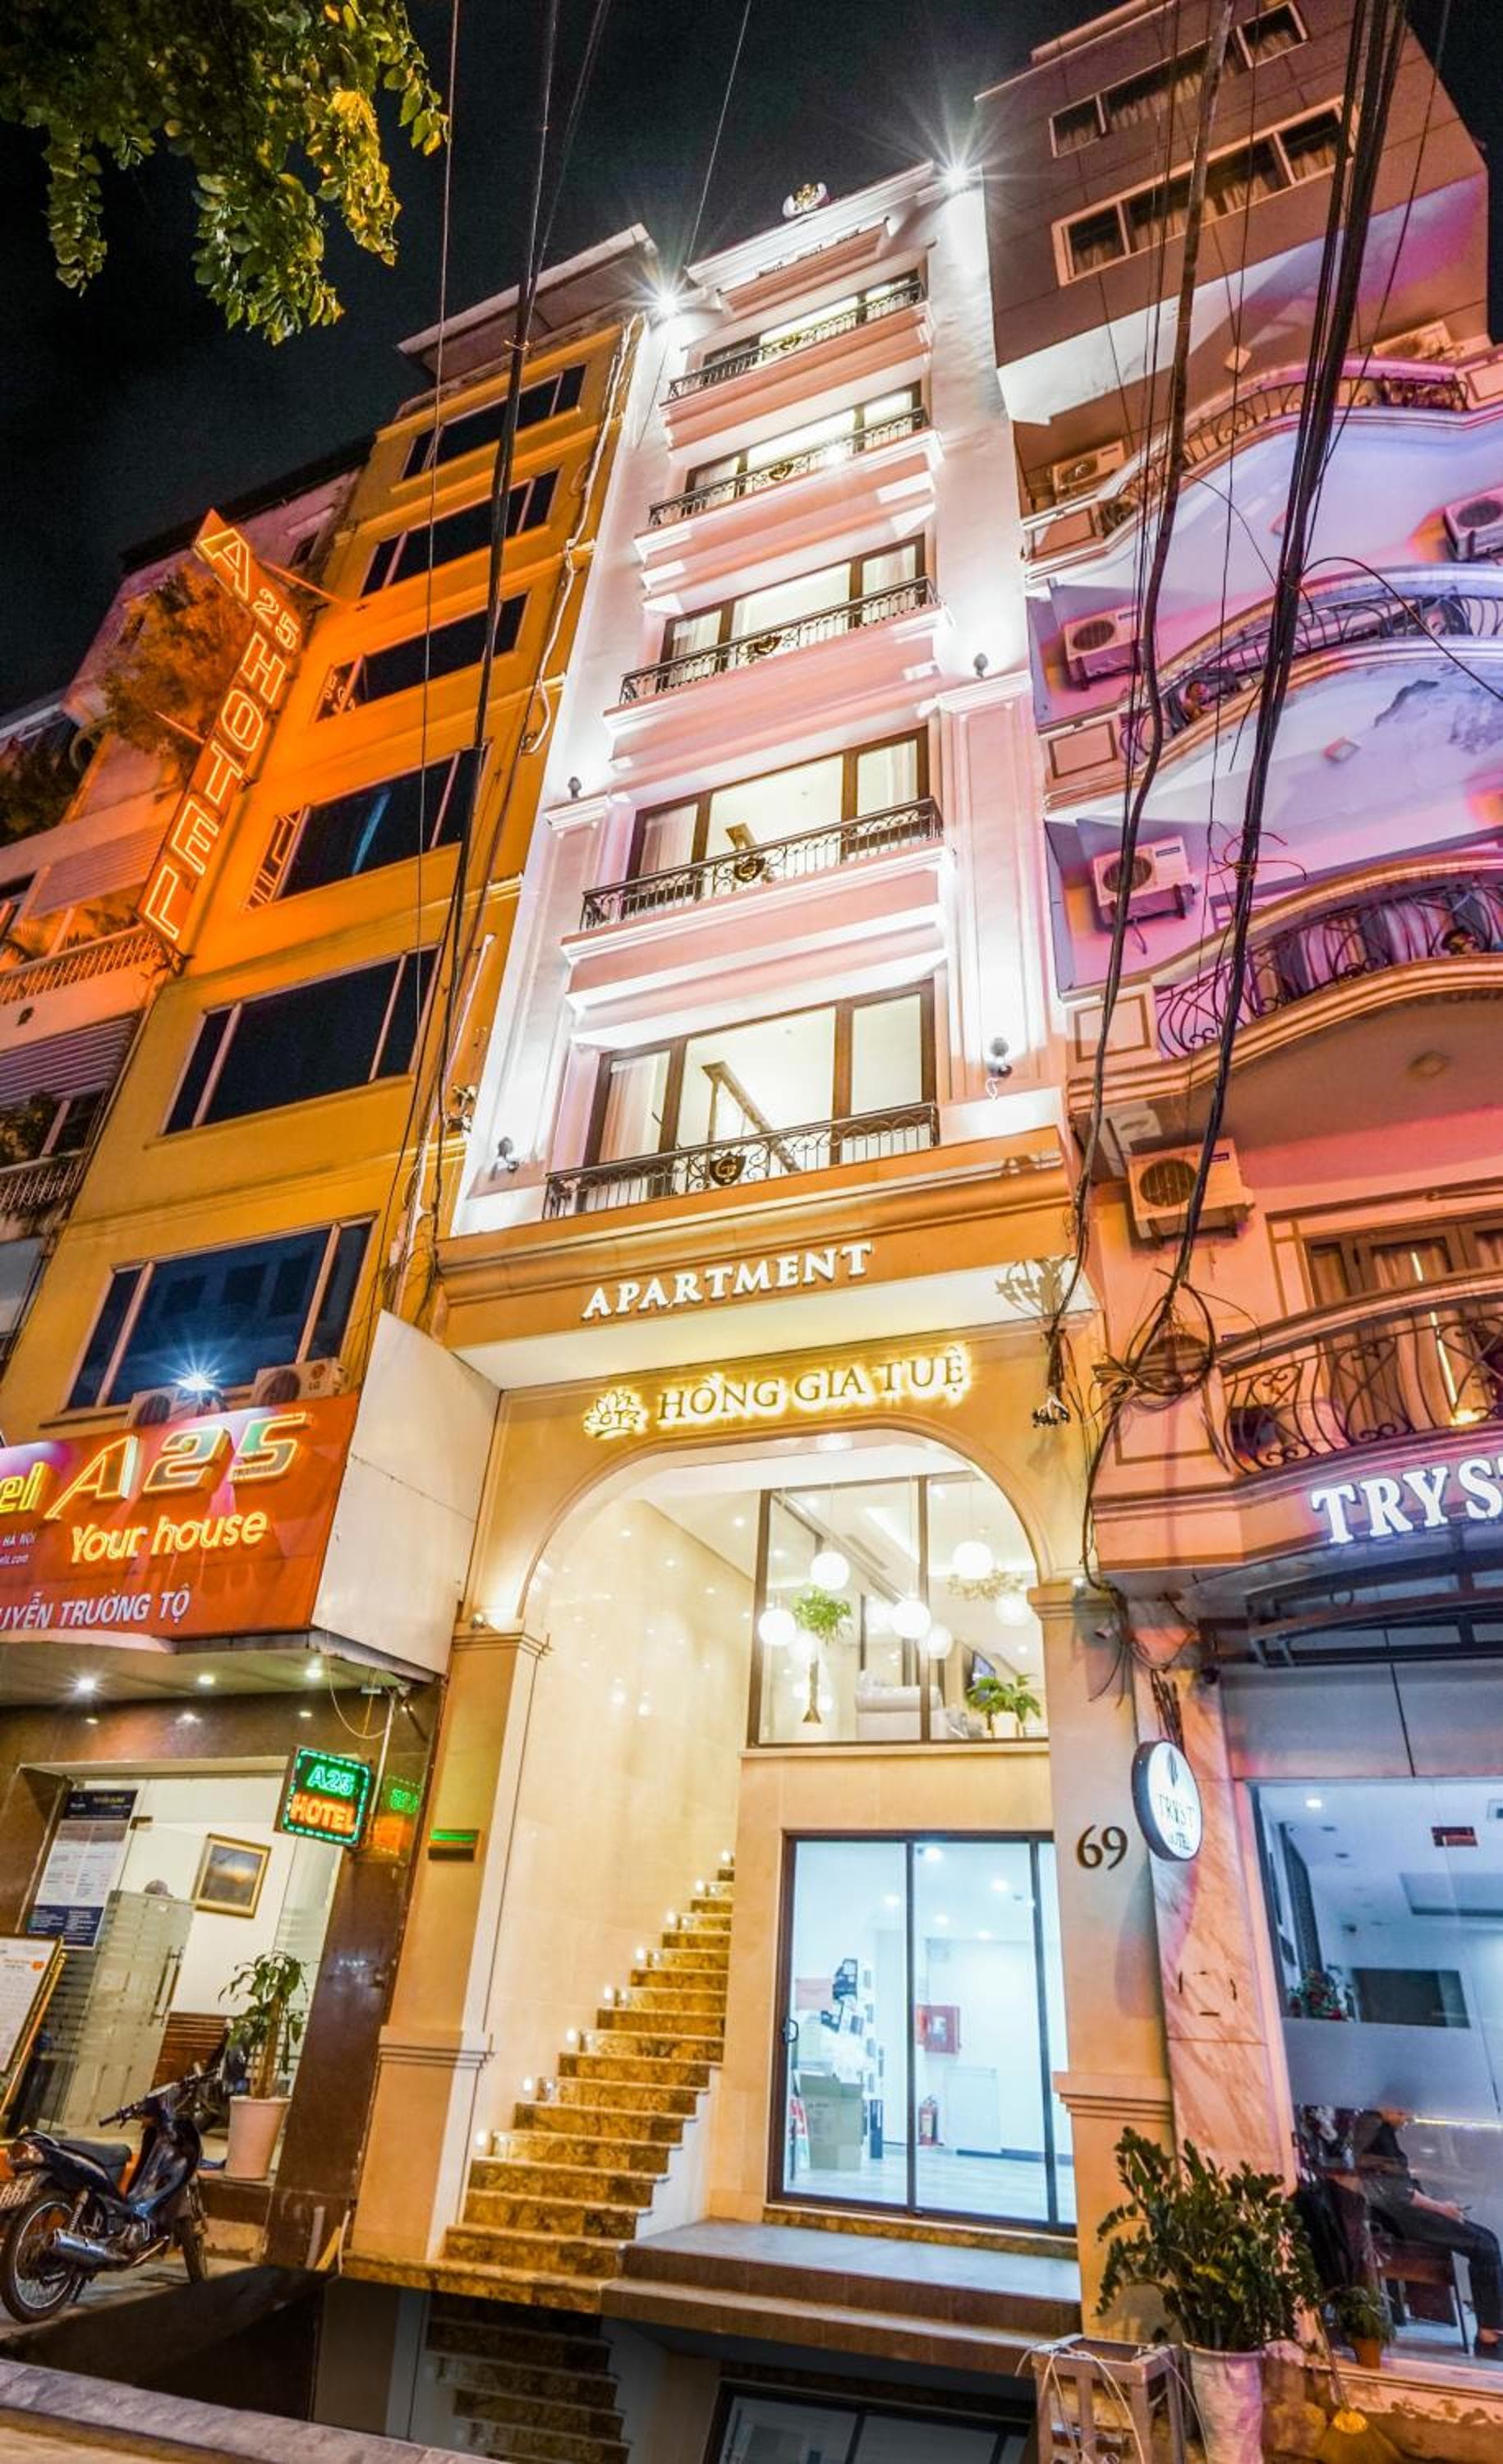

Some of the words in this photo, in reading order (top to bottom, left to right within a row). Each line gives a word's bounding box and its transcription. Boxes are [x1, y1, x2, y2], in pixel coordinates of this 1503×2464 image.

[198, 526, 301, 650] A25
[144, 630, 286, 941] HOTEL
[580, 1241, 873, 1321] APARTMENT
[657, 1372, 780, 1421] HỒNG
[793, 1366, 866, 1402] GIA
[877, 1345, 964, 1393] TUỆ
[43, 1411, 308, 1520] A25
[1311, 1456, 1503, 1544] TRYS
[71, 1523, 149, 1564] Your
[151, 1510, 269, 1556] house
[59, 1588, 153, 1628] TRƯỜNG
[159, 1583, 191, 1624] TỘ
[288, 1793, 356, 1834] HOTEL
[306, 1763, 356, 1797] A25
[1077, 1824, 1128, 1871] 69
